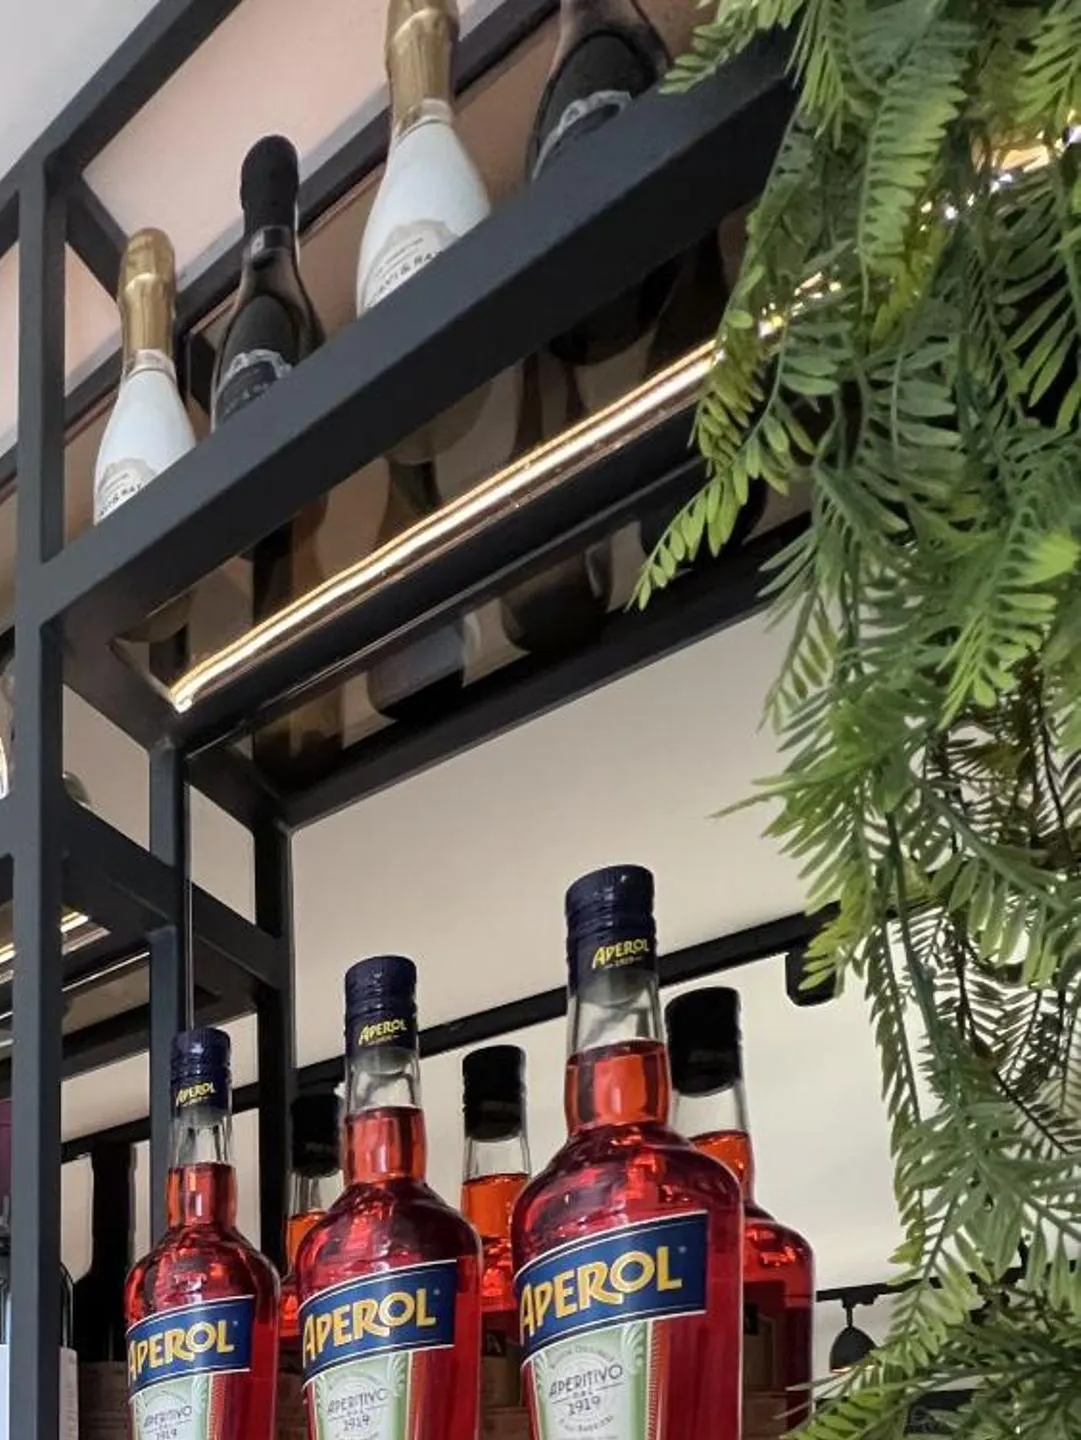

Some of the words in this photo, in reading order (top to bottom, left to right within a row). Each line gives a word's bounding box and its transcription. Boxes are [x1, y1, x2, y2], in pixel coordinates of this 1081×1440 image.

[592, 938, 650, 969] APEROL
[358, 1018, 408, 1046] APEROL
[176, 1081, 216, 1106] APEROL
[520, 1245, 683, 1346] APEROL
[303, 1288, 437, 1369] APEROL
[128, 1319, 235, 1384] APEROL
[548, 1363, 624, 1398] APERITIVO
[567, 1395, 601, 1416] 1919
